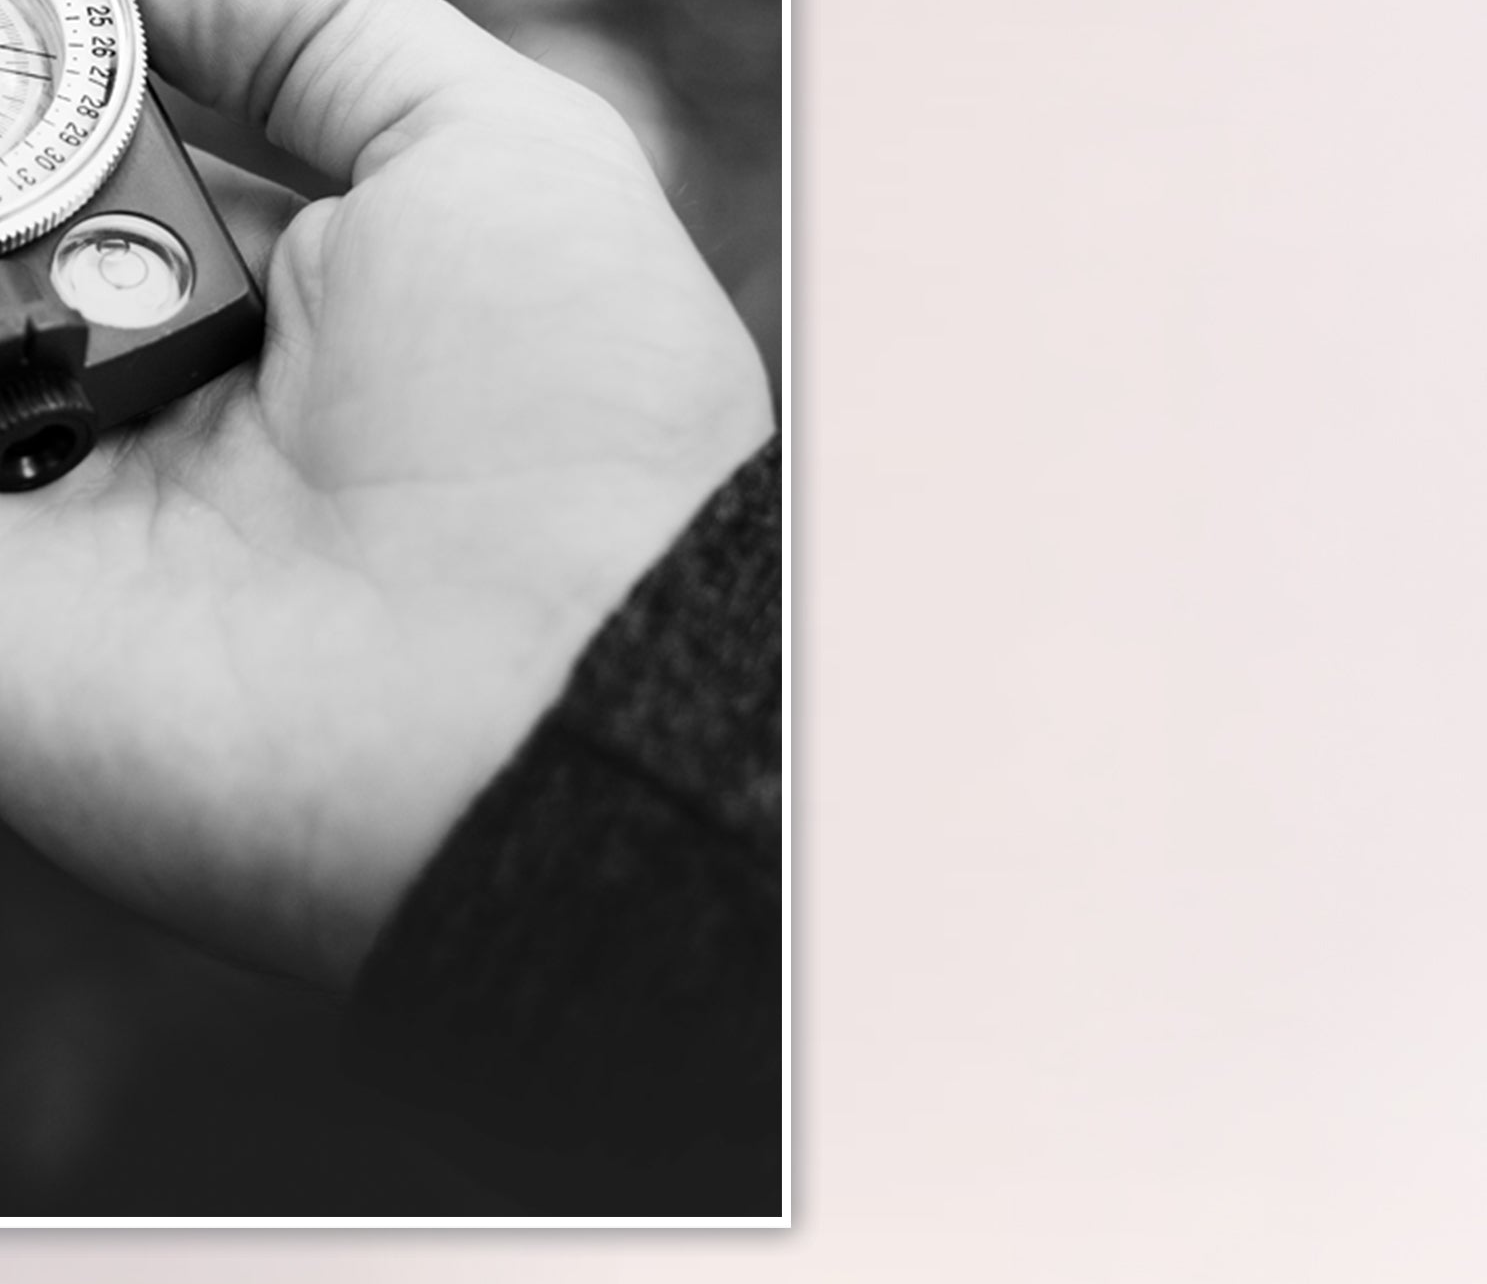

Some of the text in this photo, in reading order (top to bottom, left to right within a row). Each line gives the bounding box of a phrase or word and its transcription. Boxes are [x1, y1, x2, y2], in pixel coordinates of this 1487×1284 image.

[86, 5, 114, 28] 25
[91, 35, 117, 58] 26
[76, 94, 102, 120] 28
[59, 121, 88, 147] 29
[34, 146, 65, 172] 30
[8, 167, 37, 191] 31
